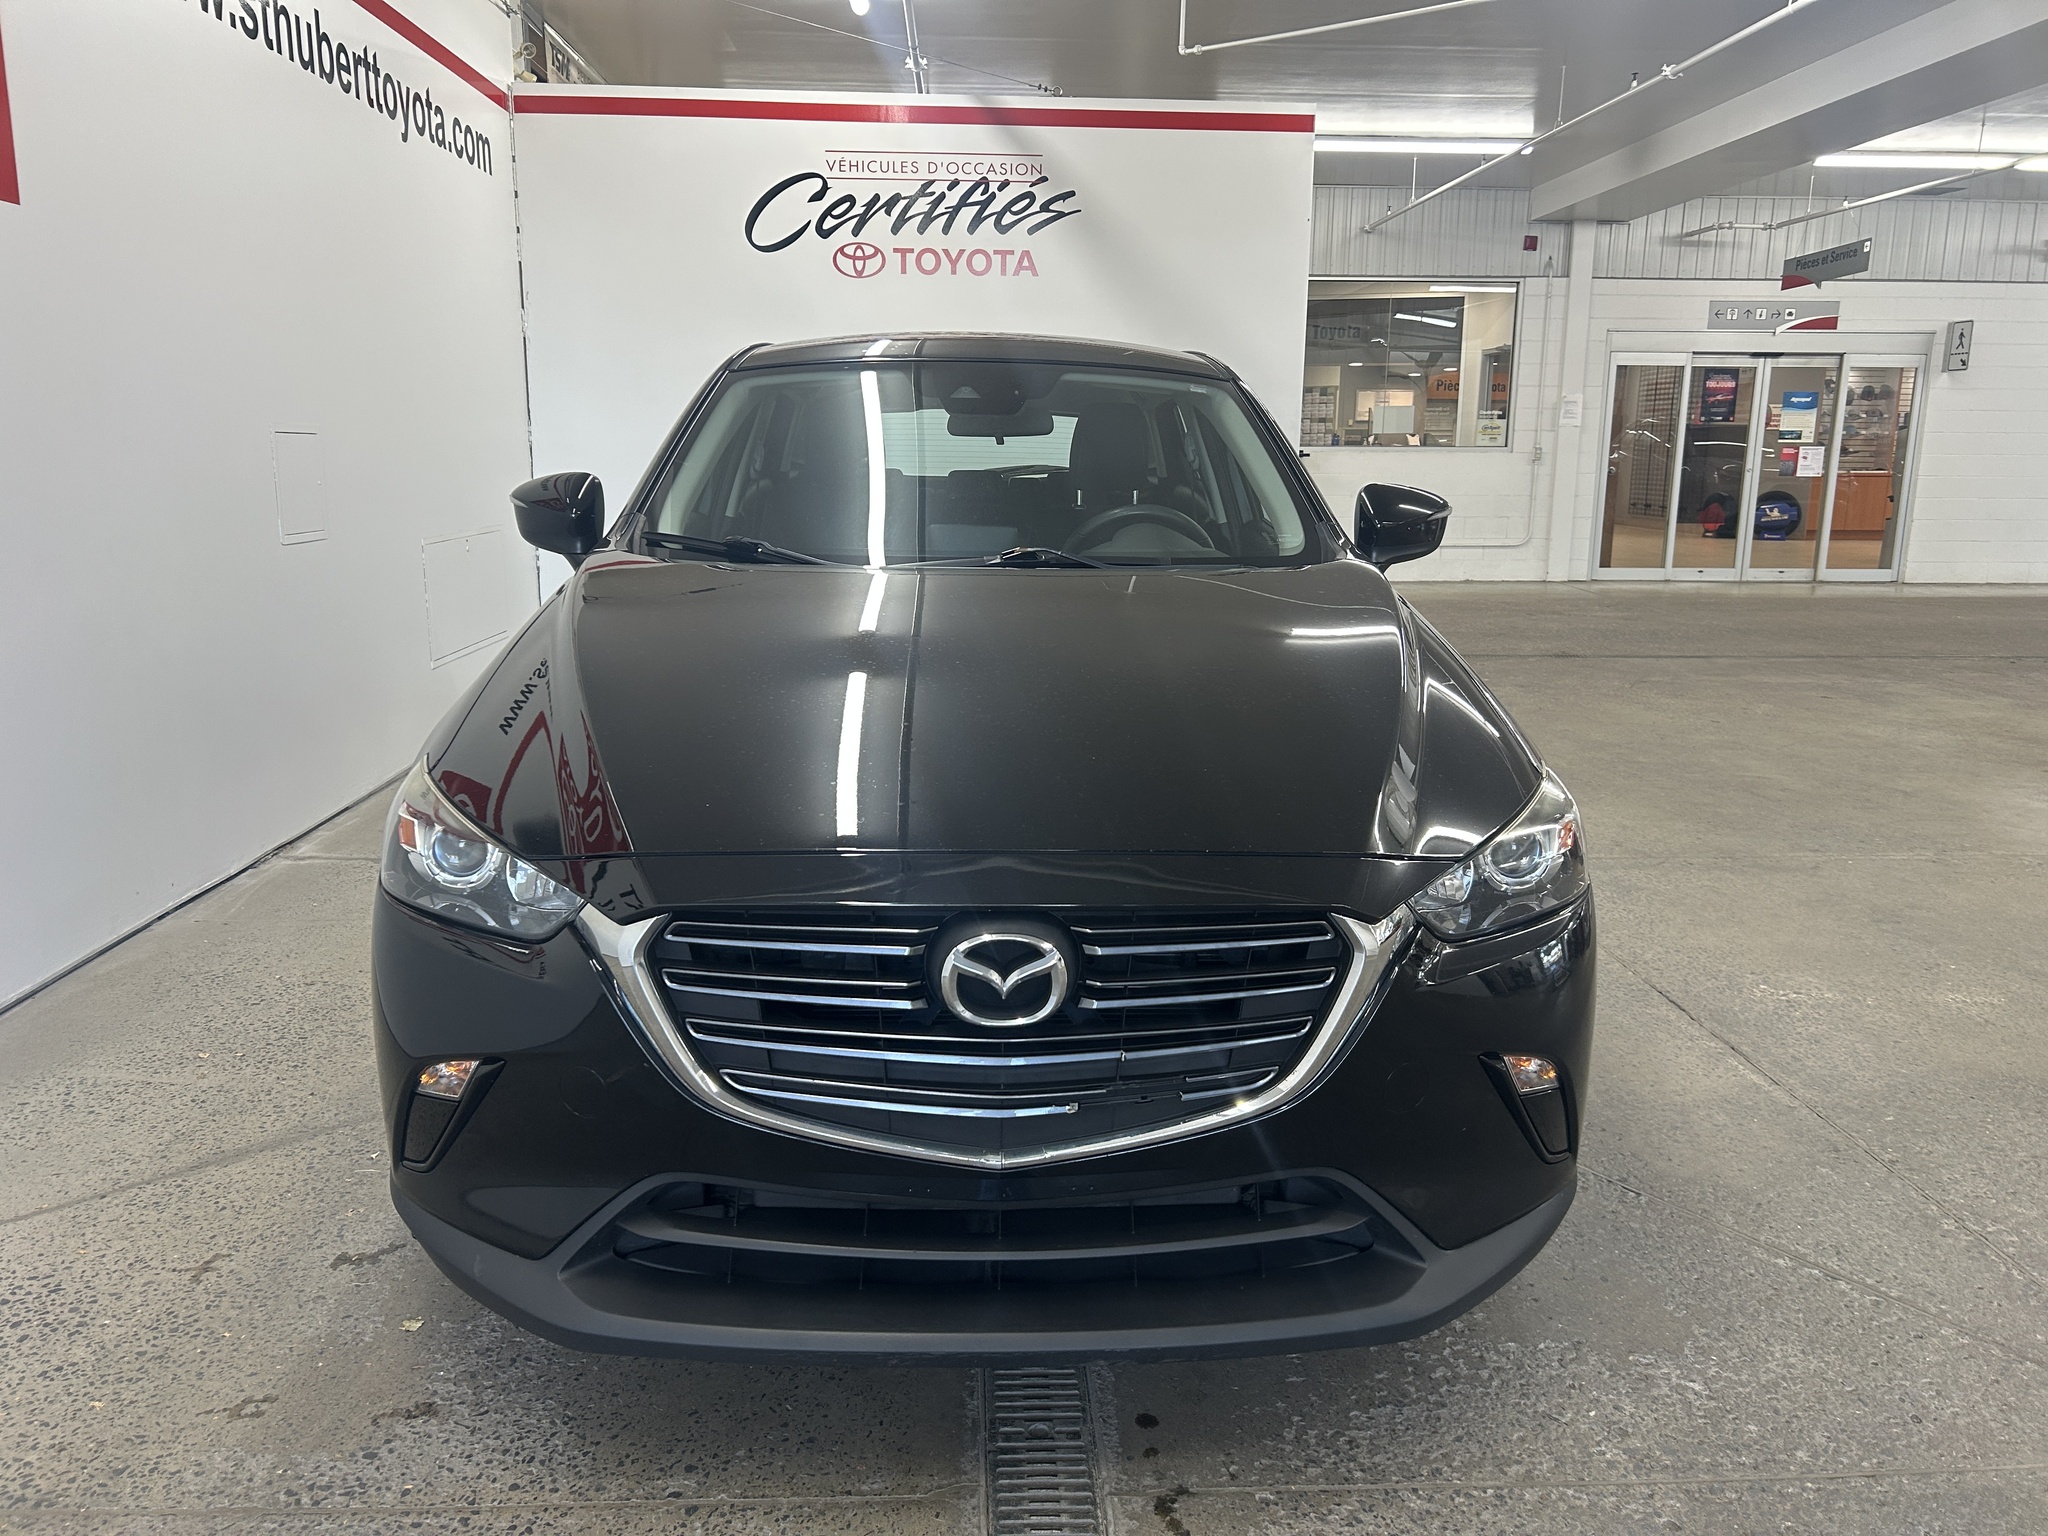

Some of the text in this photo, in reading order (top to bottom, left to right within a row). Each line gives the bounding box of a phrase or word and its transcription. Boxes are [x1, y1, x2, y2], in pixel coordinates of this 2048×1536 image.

[200, 0, 493, 176] .sthuberttoyota.com
[826, 156, 1043, 176] VÉHICULES D'OCCASION
[744, 171, 1082, 253] Certifiés
[893, 248, 1039, 277] TOYOTA
[1795, 247, 1858, 271] Pièces et Service
[1312, 324, 1361, 340] Toyota
